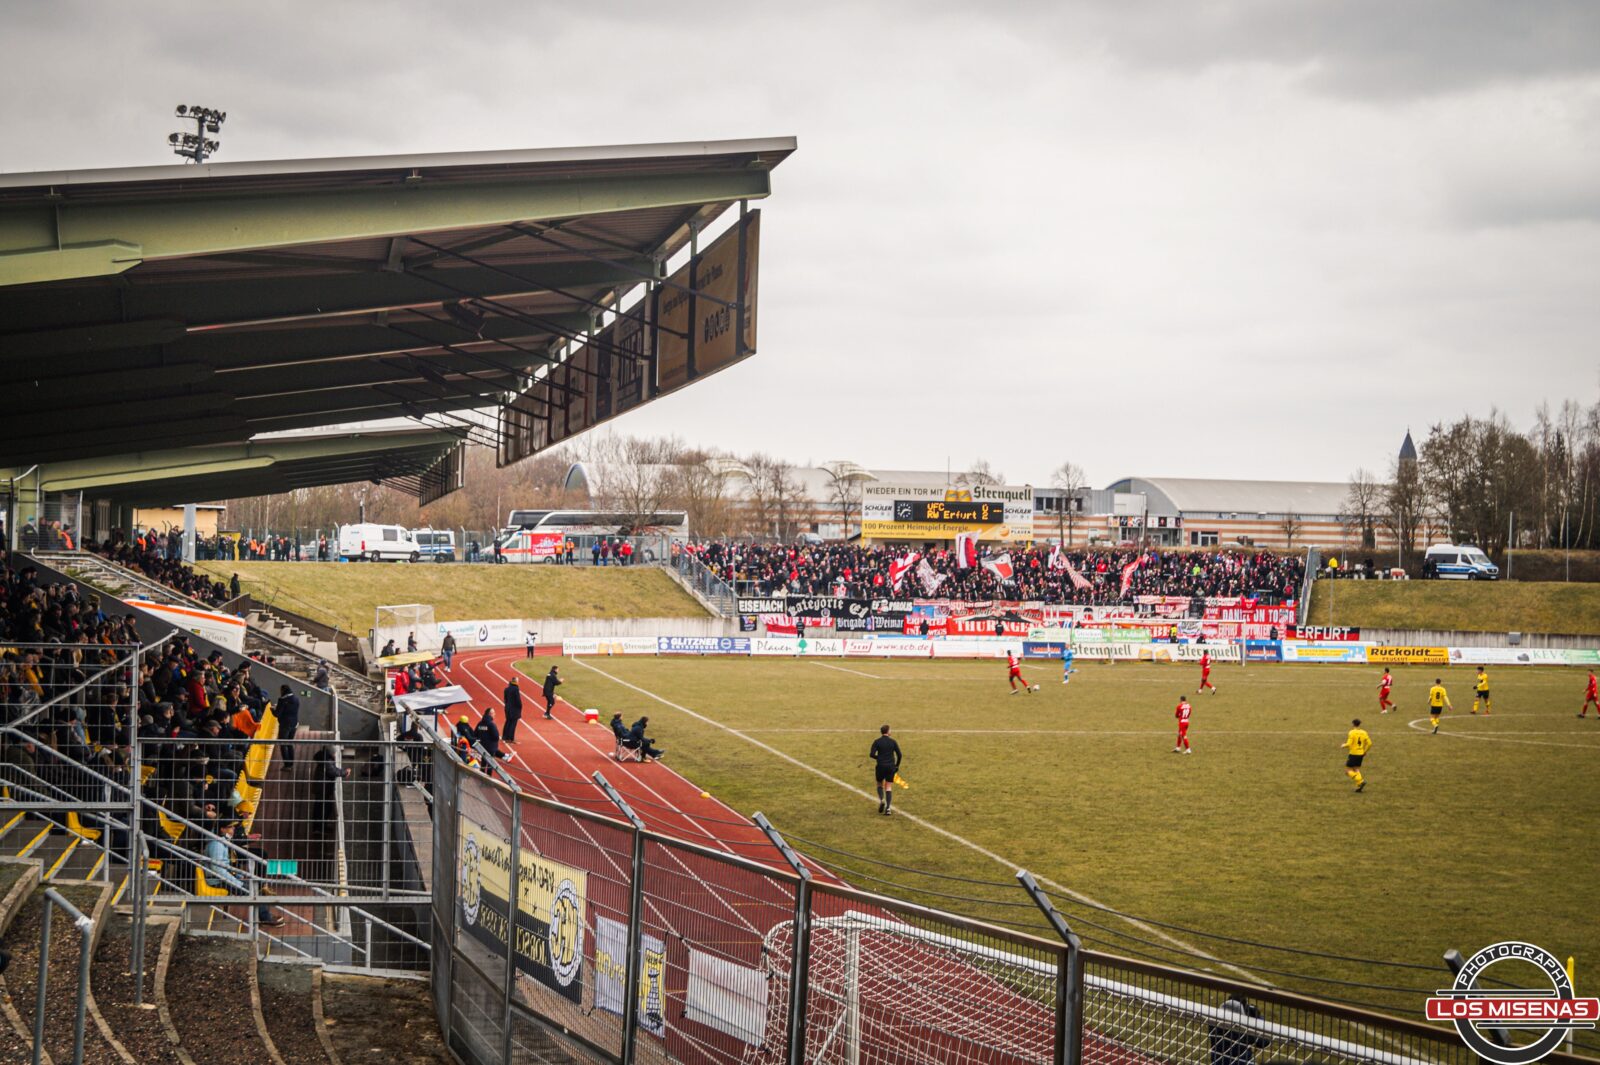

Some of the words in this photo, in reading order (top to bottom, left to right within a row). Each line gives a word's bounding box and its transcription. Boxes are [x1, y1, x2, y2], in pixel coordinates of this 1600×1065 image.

[865, 487, 896, 495] WIEDER
[930, 488, 943, 496] MIT
[974, 486, 1032, 502] Sternquell
[943, 510, 977, 519] Erfurt
[738, 600, 784, 613] EISENACH
[874, 616, 904, 628] Weimar
[1295, 626, 1351, 640] ERFURT
[757, 640, 792, 651] Plauen
[815, 641, 837, 651] Park
[1071, 643, 1132, 657] Sternquell
[1177, 645, 1238, 659] Sterquell
